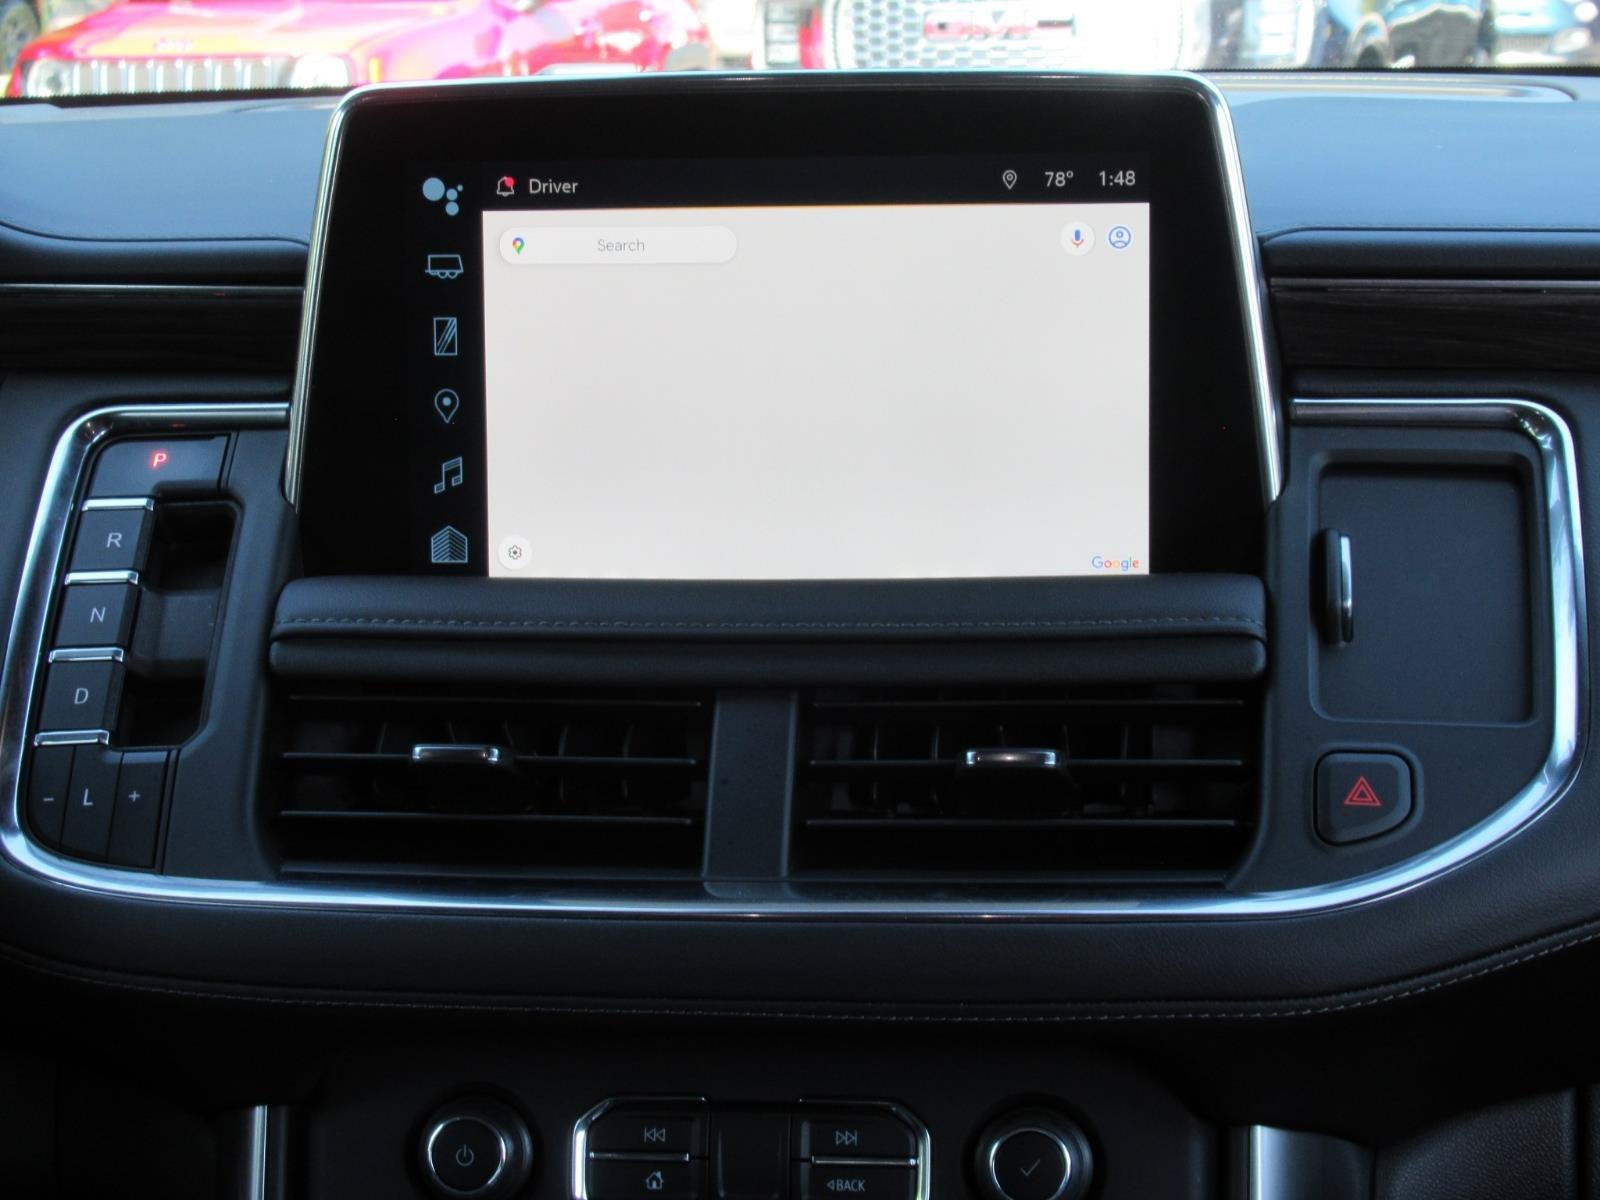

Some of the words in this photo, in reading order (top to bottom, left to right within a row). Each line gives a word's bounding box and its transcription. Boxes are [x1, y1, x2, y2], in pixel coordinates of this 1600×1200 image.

[528, 178, 579, 195] Driver
[1099, 170, 1136, 187] 1:48
[597, 238, 646, 253] Search
[151, 452, 168, 468] P
[106, 532, 122, 548] R
[1091, 554, 1140, 572] Google
[89, 607, 106, 623] N
[73, 687, 90, 705] D
[82, 788, 94, 806] L
[836, 1178, 866, 1192] BACK
